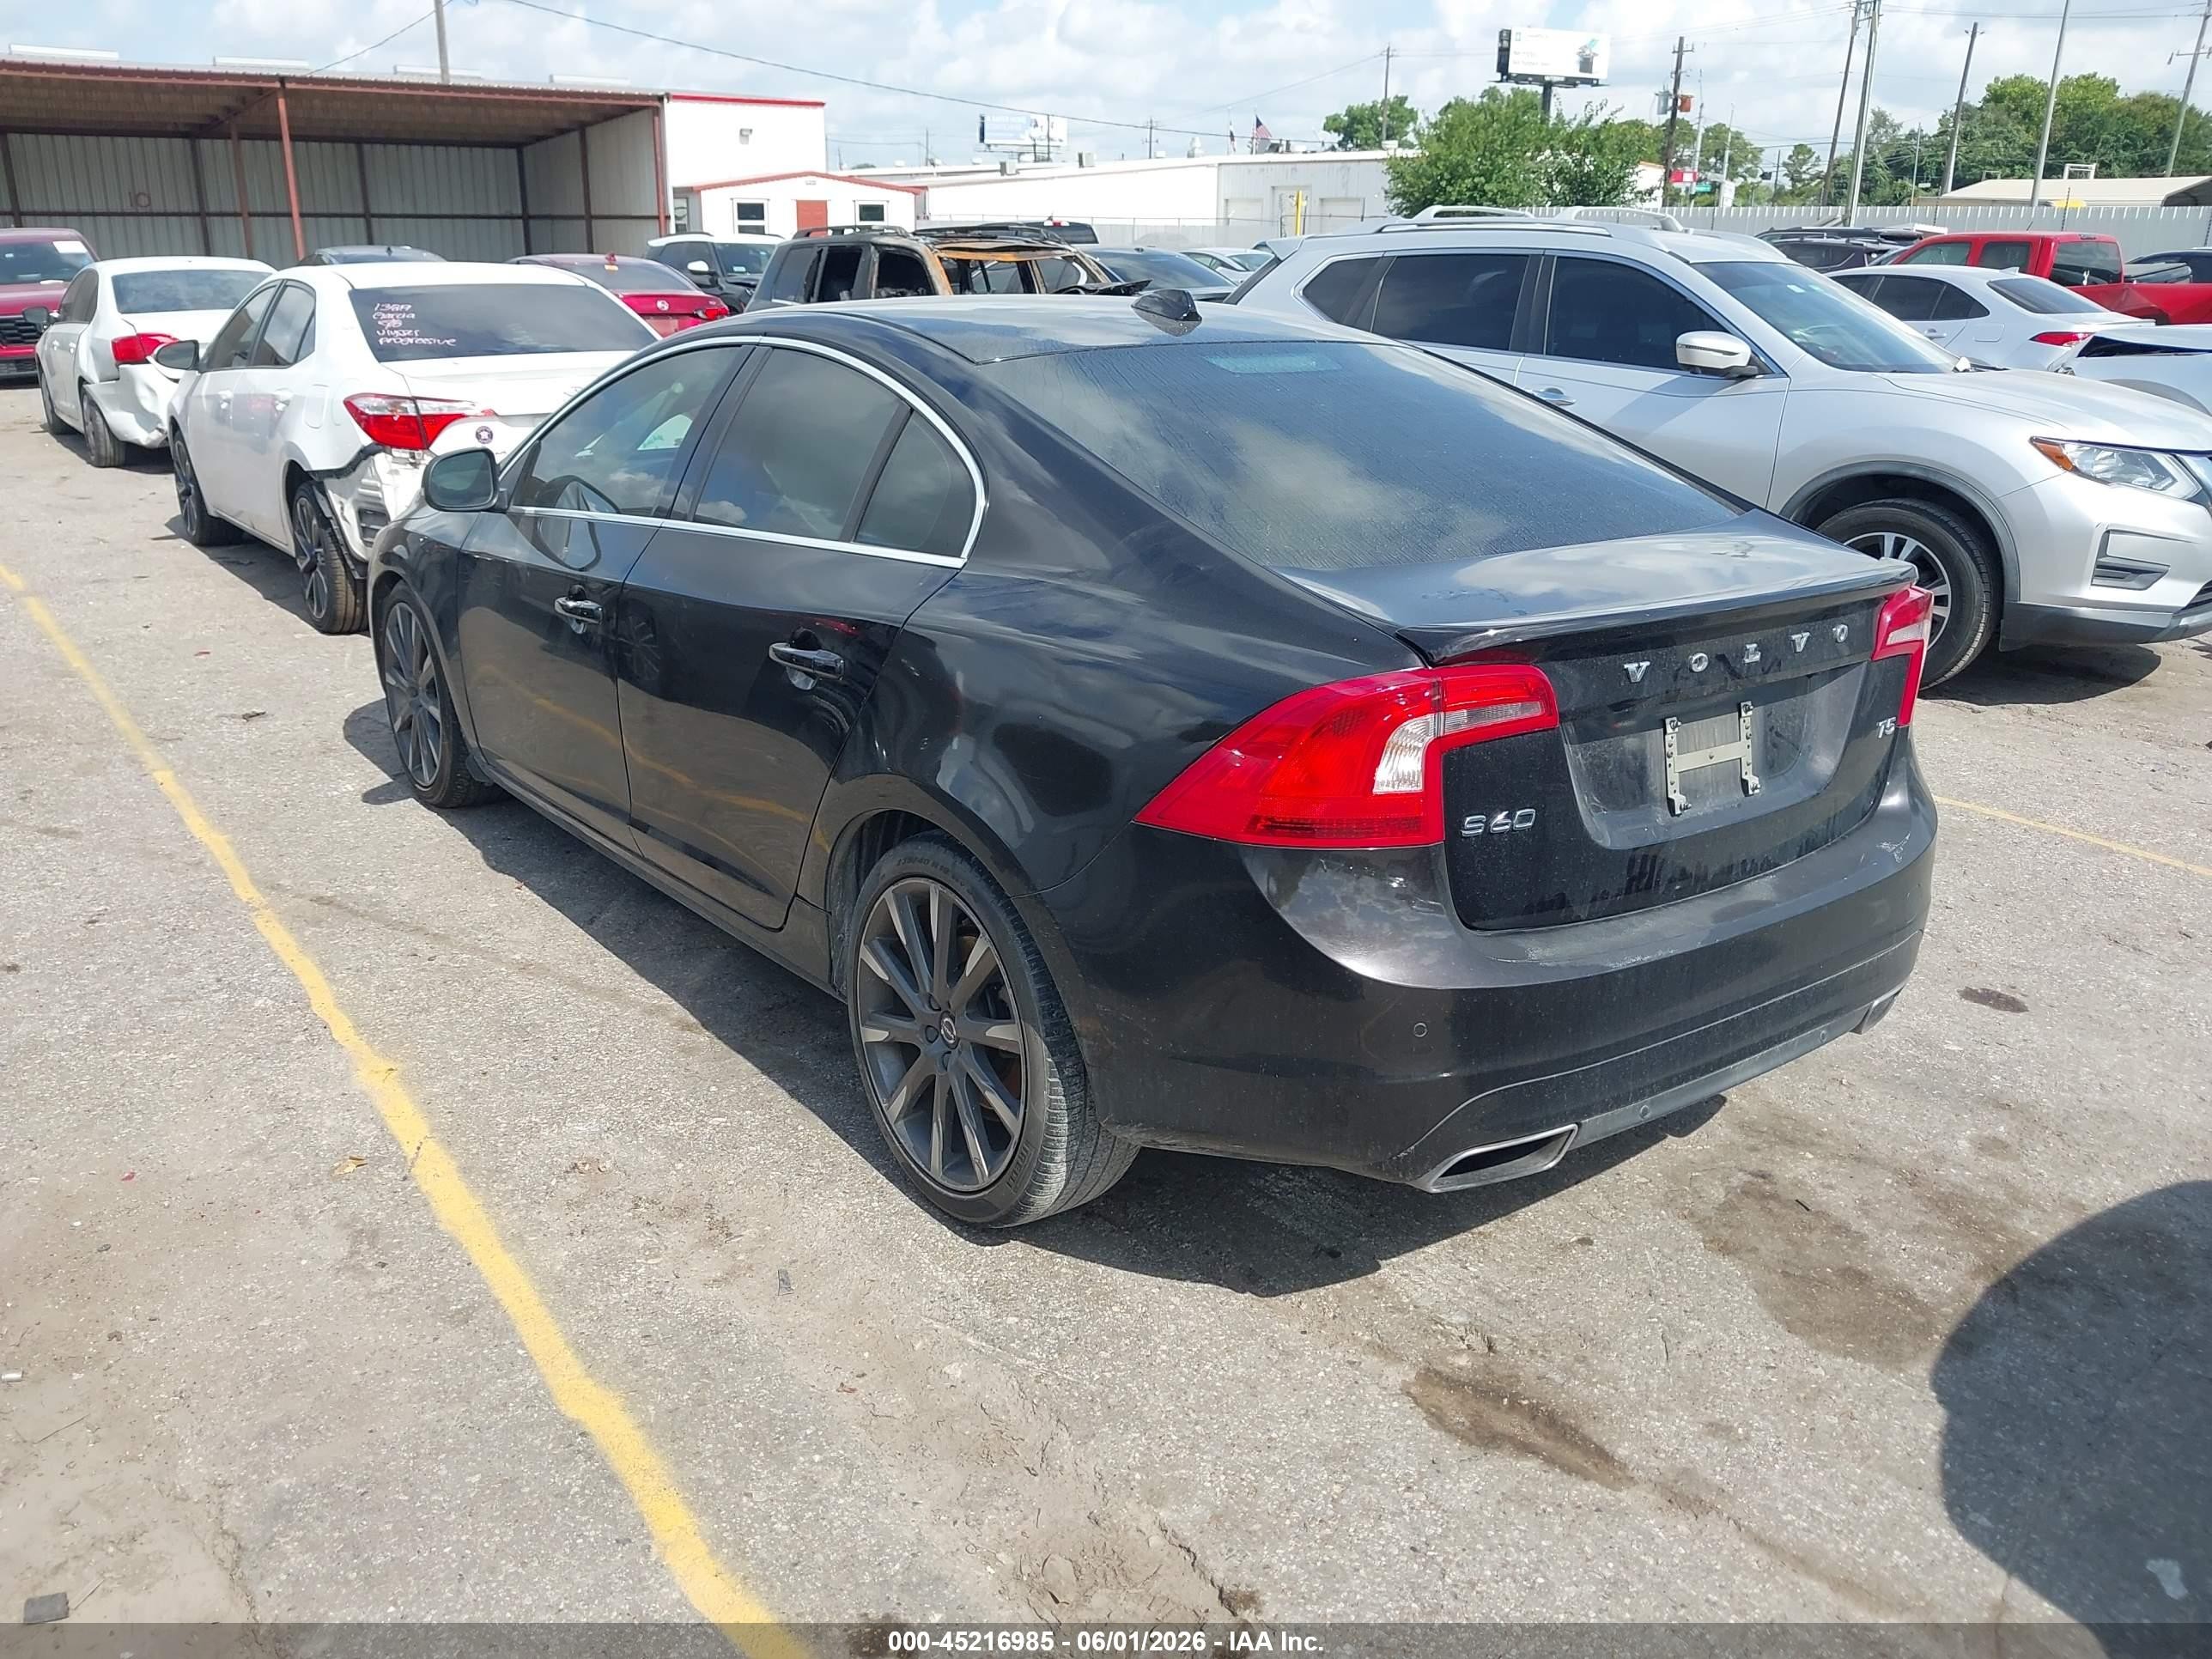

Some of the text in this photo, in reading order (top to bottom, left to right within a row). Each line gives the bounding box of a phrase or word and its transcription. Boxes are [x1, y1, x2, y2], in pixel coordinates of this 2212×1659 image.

[1624, 623, 1849, 683] VOLVO
[1876, 716, 1897, 738] T5
[1461, 809, 1536, 837] S60
